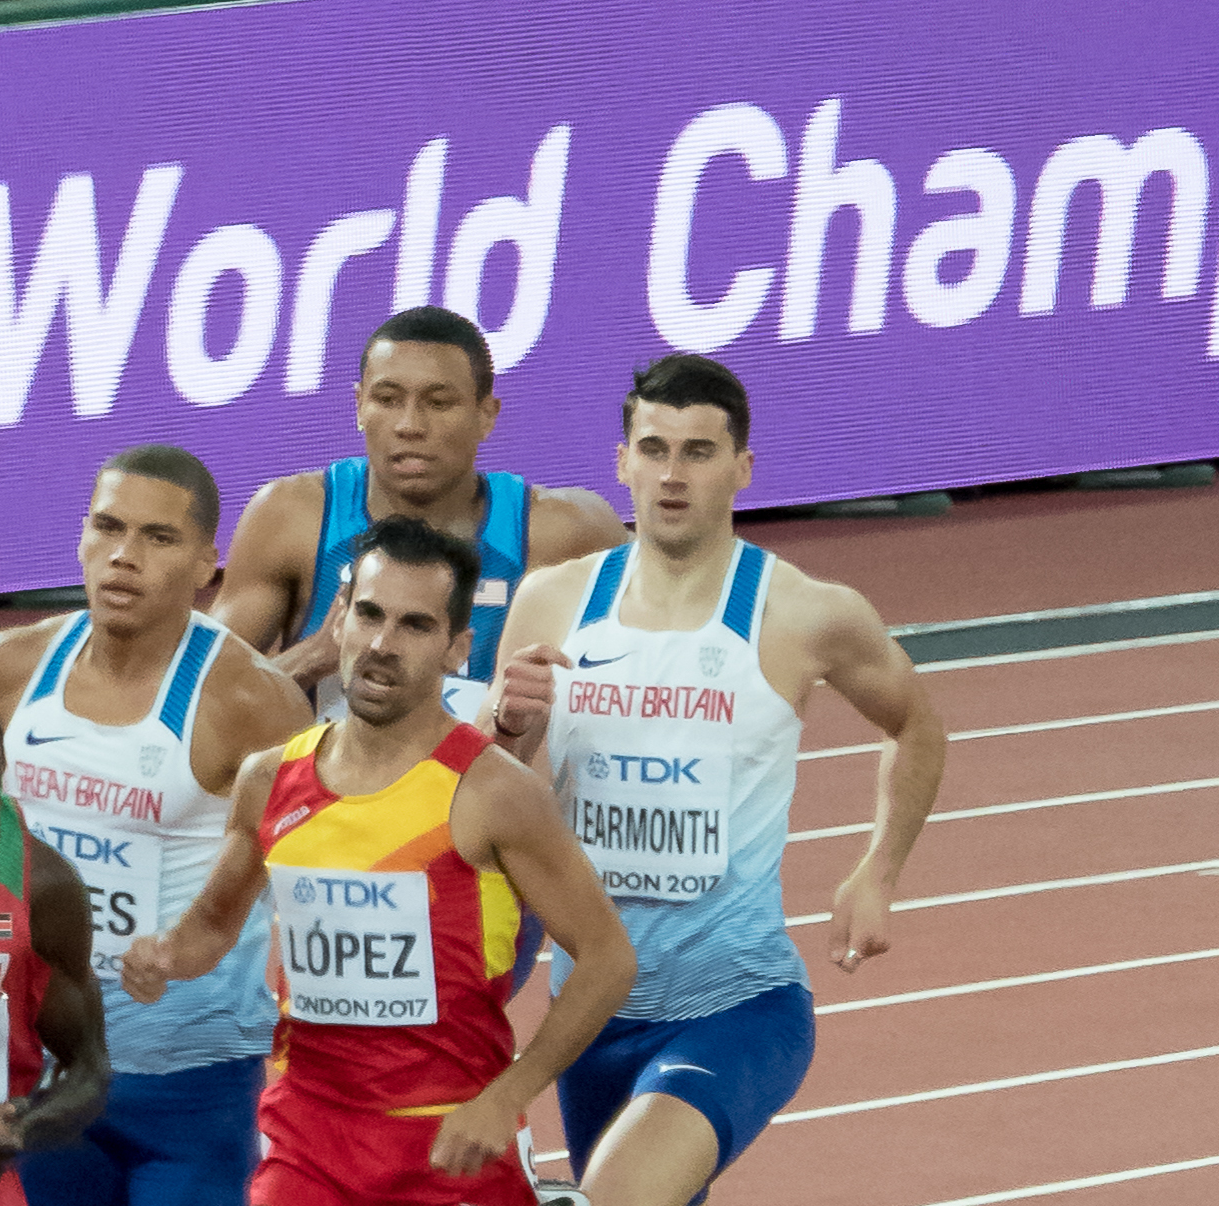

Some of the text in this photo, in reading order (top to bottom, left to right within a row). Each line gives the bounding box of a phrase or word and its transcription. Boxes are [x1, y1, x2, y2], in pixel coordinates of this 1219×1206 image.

[647, 96, 1219, 358] Cham
[569, 681, 736, 724] GREAT BRITAIN
[610, 754, 702, 784] TDK
[75, 774, 164, 823] BRITAIN
[48, 826, 132, 868] TDK
[317, 877, 398, 910] TDK
[667, 874, 722, 893] 2017
[288, 917, 420, 979] LÓPEZ
[374, 998, 429, 1018] 2017
